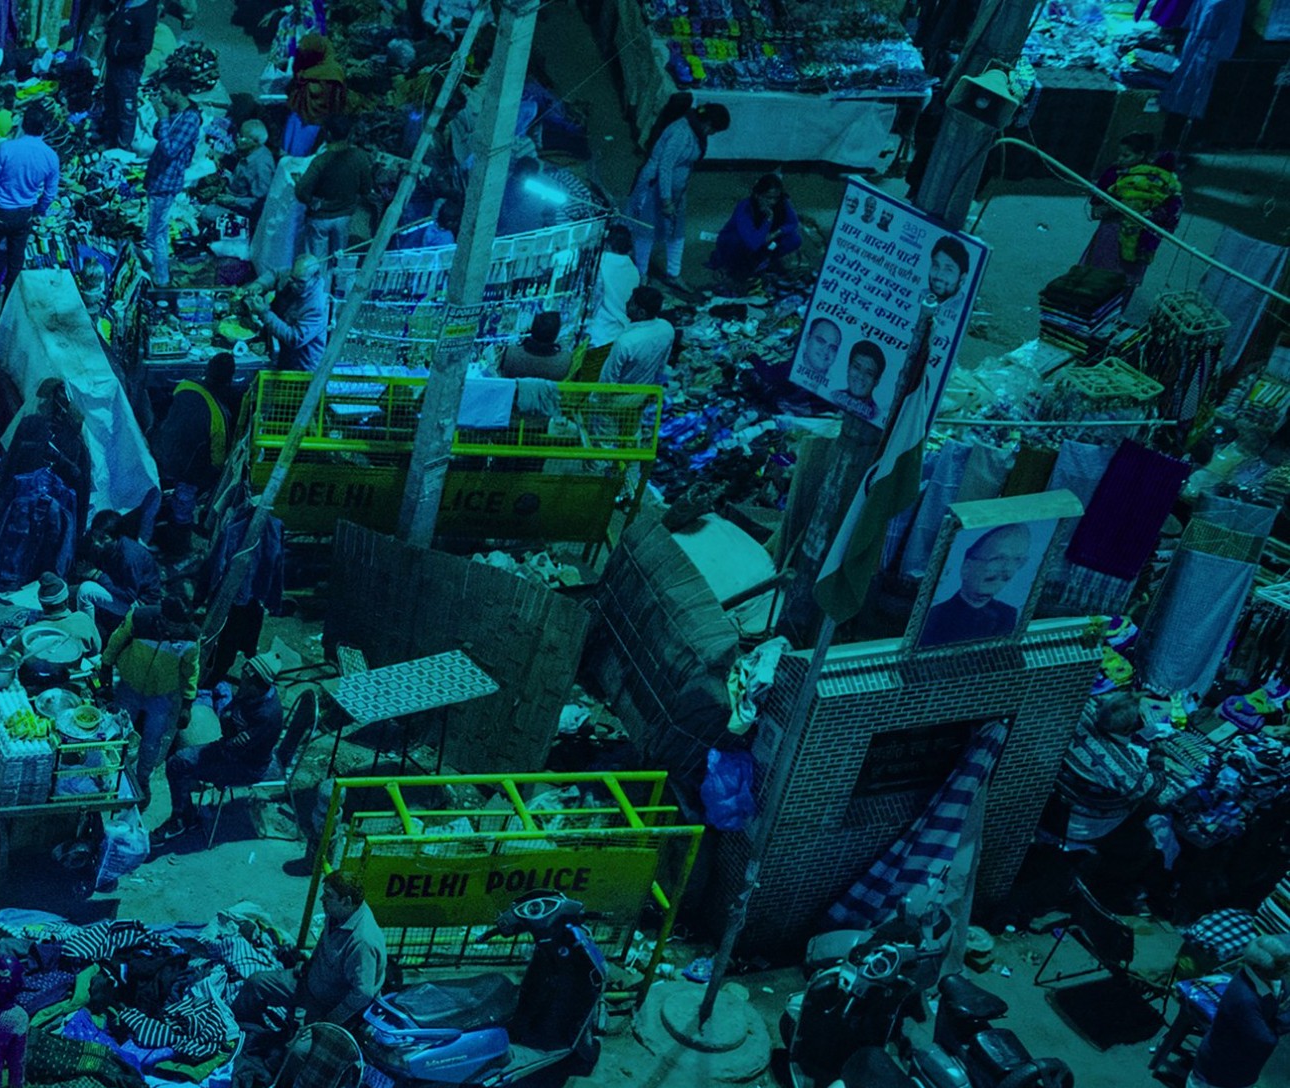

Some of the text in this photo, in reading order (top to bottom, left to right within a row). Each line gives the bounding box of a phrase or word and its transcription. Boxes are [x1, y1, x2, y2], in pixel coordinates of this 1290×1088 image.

[839, 222, 862, 239] आम
[861, 230, 896, 256] आदमी
[896, 245, 921, 267] पार्टी
[821, 277, 839, 294] श्री
[895, 297, 912, 311] पर
[288, 481, 507, 513] DELHI LICE
[386, 867, 591, 898] DELHI POLICE
